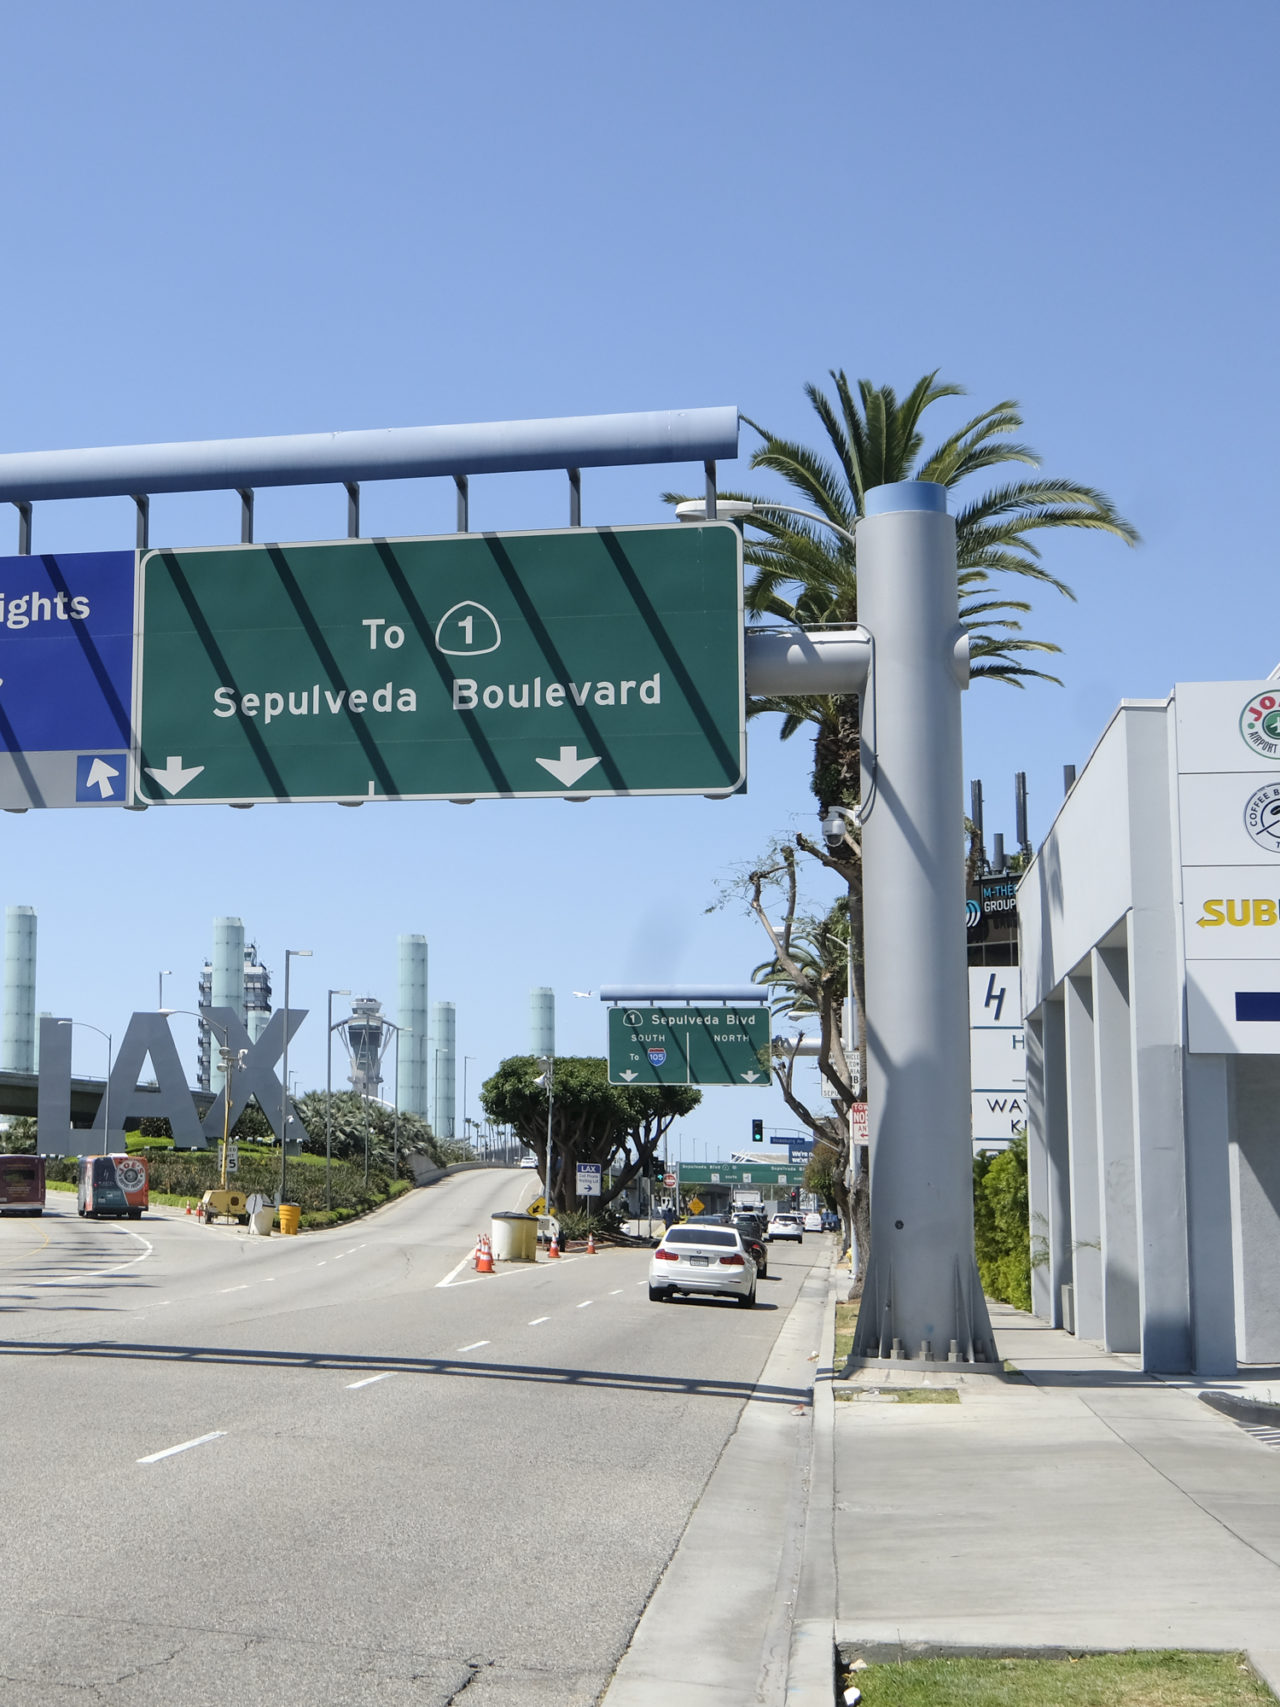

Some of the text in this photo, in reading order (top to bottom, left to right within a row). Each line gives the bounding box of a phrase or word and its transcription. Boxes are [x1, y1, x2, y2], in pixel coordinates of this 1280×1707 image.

[362, 615, 474, 650] To 1
[212, 672, 662, 724] Sepulveda Boulevard
[1248, 695, 1280, 722] JO
[1248, 731, 1278, 754] AIRPORT
[1249, 792, 1270, 827] COFFEE
[984, 898, 1016, 913] GROUP
[1196, 898, 1280, 928] SUB
[629, 1014, 756, 1027] 1 Sepulveda Blvd
[631, 1034, 665, 1042] SOUTH
[714, 1034, 749, 1042] NORTH
[629, 1053, 664, 1061] To 105
[37, 1007, 310, 1156] LAX
